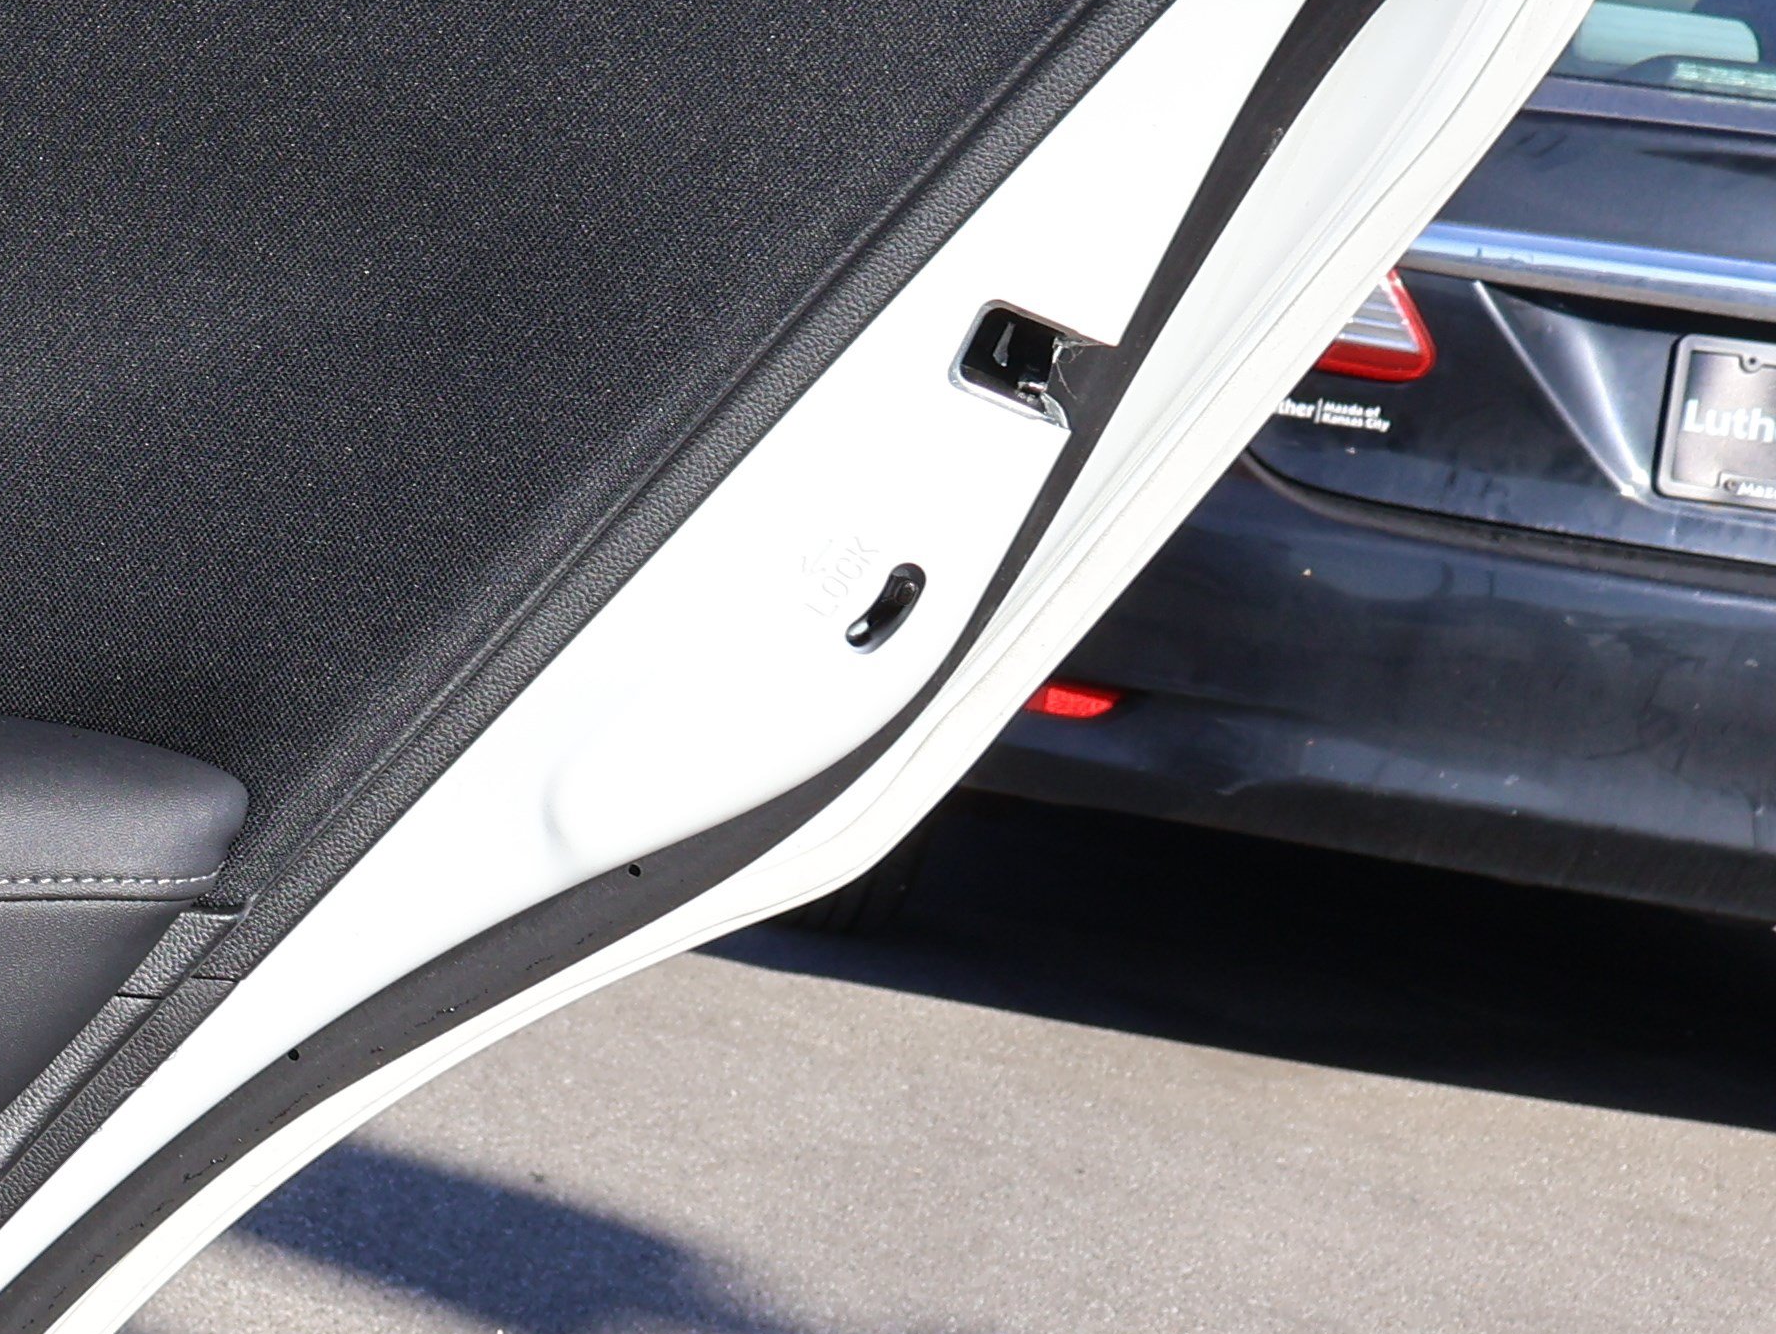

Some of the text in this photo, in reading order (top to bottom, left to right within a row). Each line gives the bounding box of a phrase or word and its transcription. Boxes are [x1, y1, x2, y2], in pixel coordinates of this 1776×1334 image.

[1271, 397, 1315, 418] ther
[1683, 399, 1776, 444] Luth
[803, 535, 880, 618] LOCK
